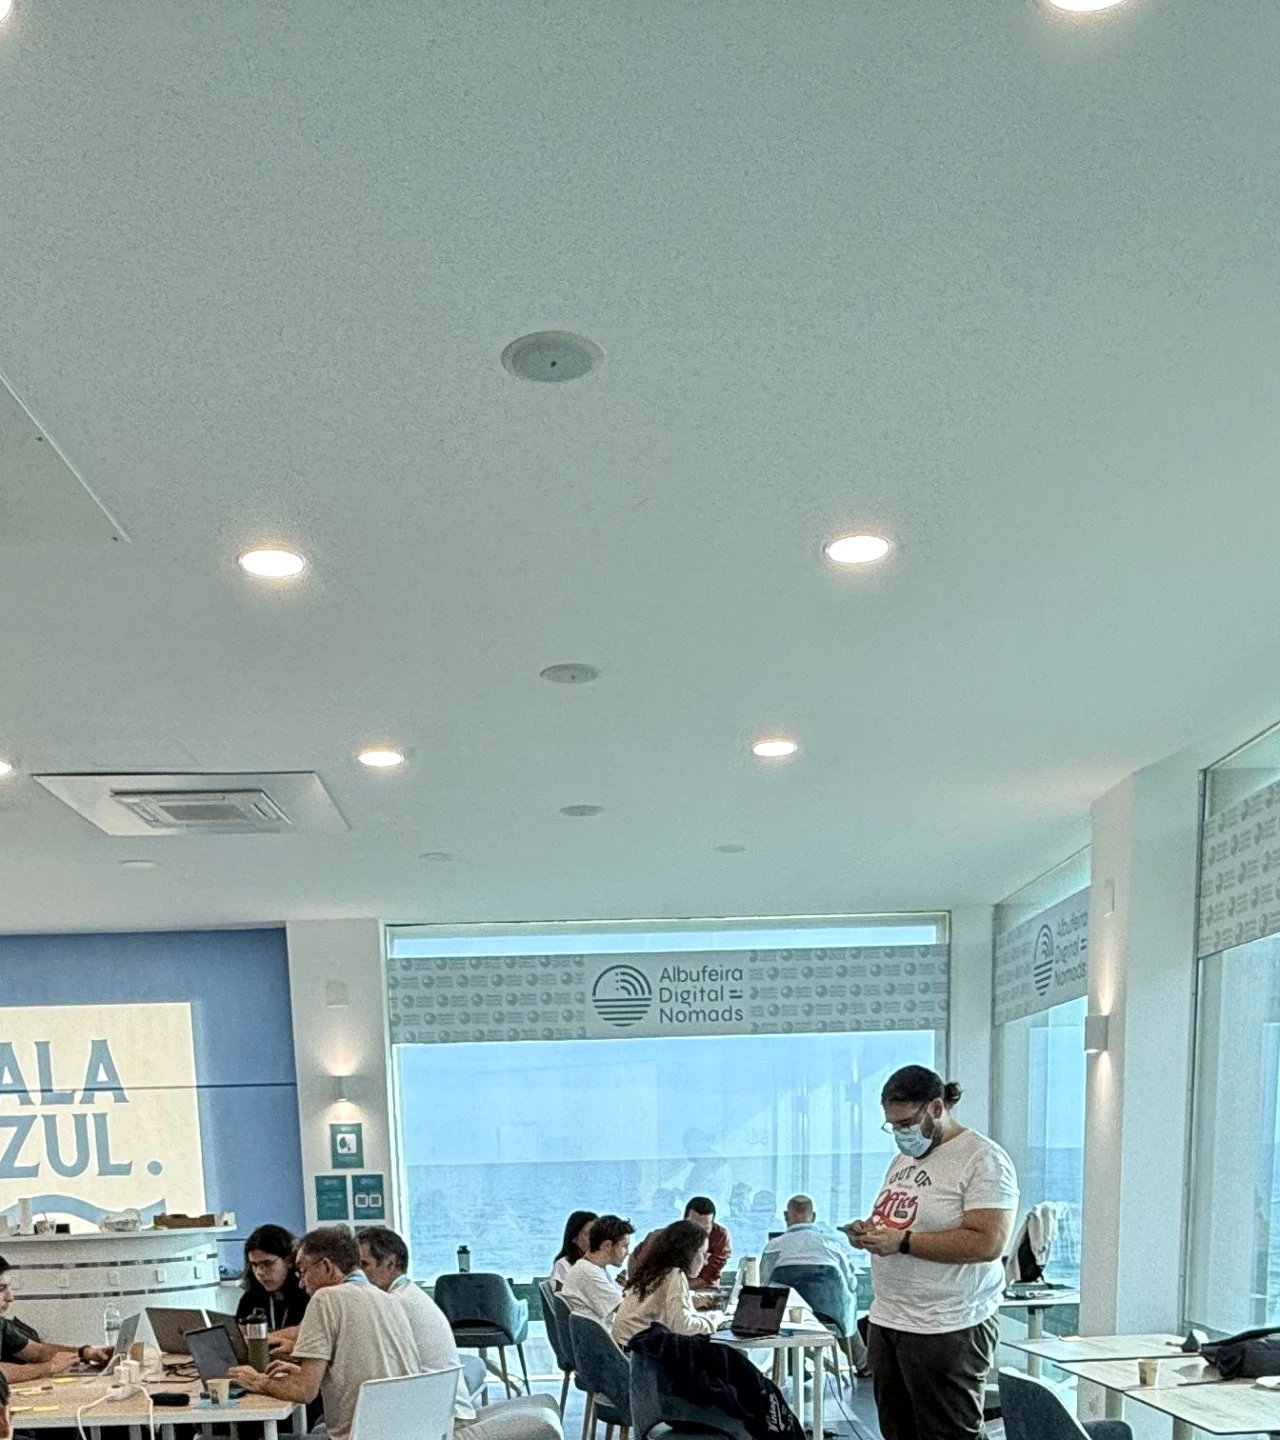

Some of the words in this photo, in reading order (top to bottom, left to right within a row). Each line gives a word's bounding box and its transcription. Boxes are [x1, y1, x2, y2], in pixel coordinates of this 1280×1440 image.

[659, 964, 744, 984] Albufeira
[659, 985, 724, 1008] Digital
[659, 1005, 744, 1024] Nomads
